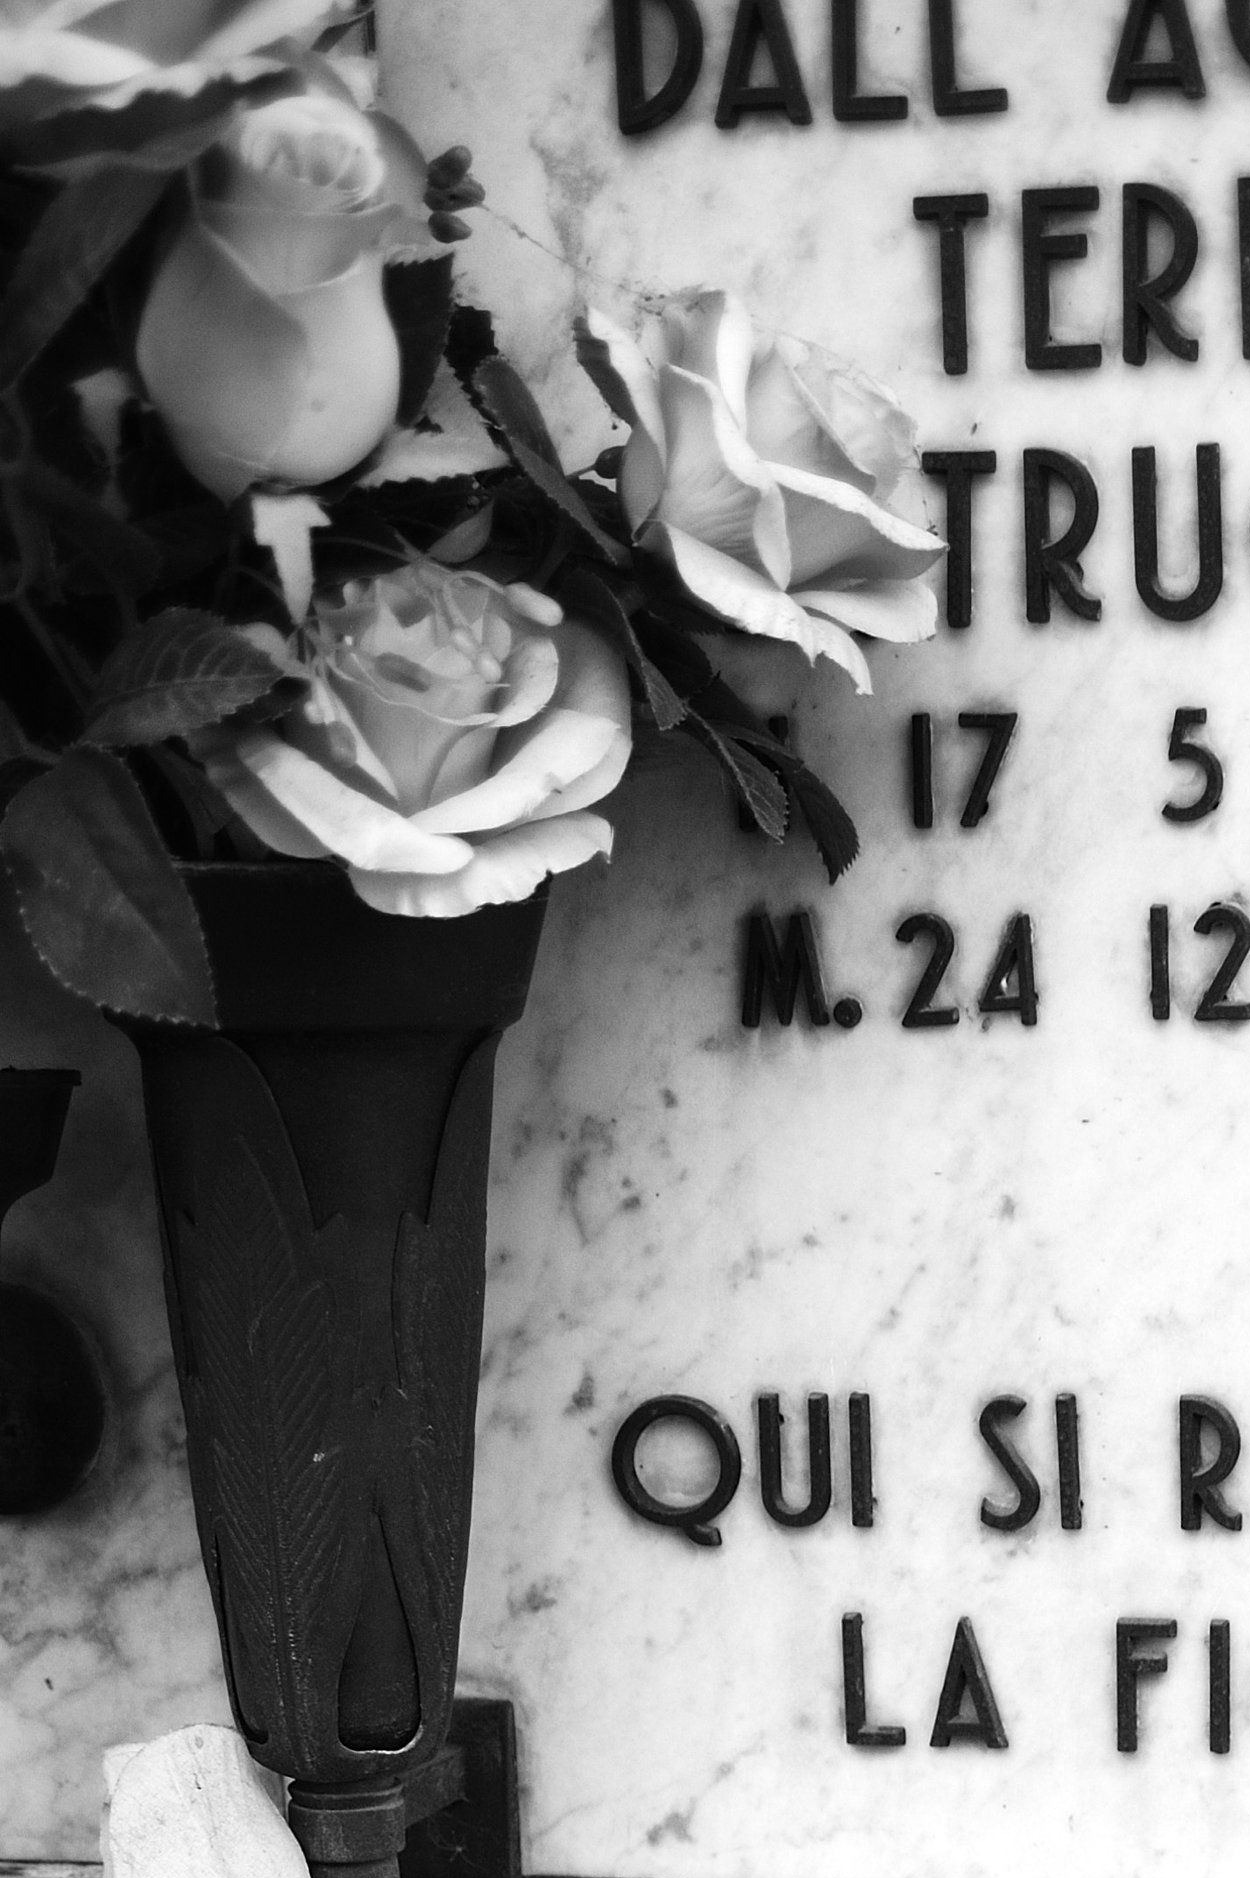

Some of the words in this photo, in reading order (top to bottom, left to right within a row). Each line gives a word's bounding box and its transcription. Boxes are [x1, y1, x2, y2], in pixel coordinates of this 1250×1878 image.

[909, 708, 1020, 834] 17
[1160, 706, 1225, 827] 5
[604, 1391, 879, 1551] QUI
[977, 1394, 1086, 1536] SI
[840, 1611, 1010, 1752] LA
